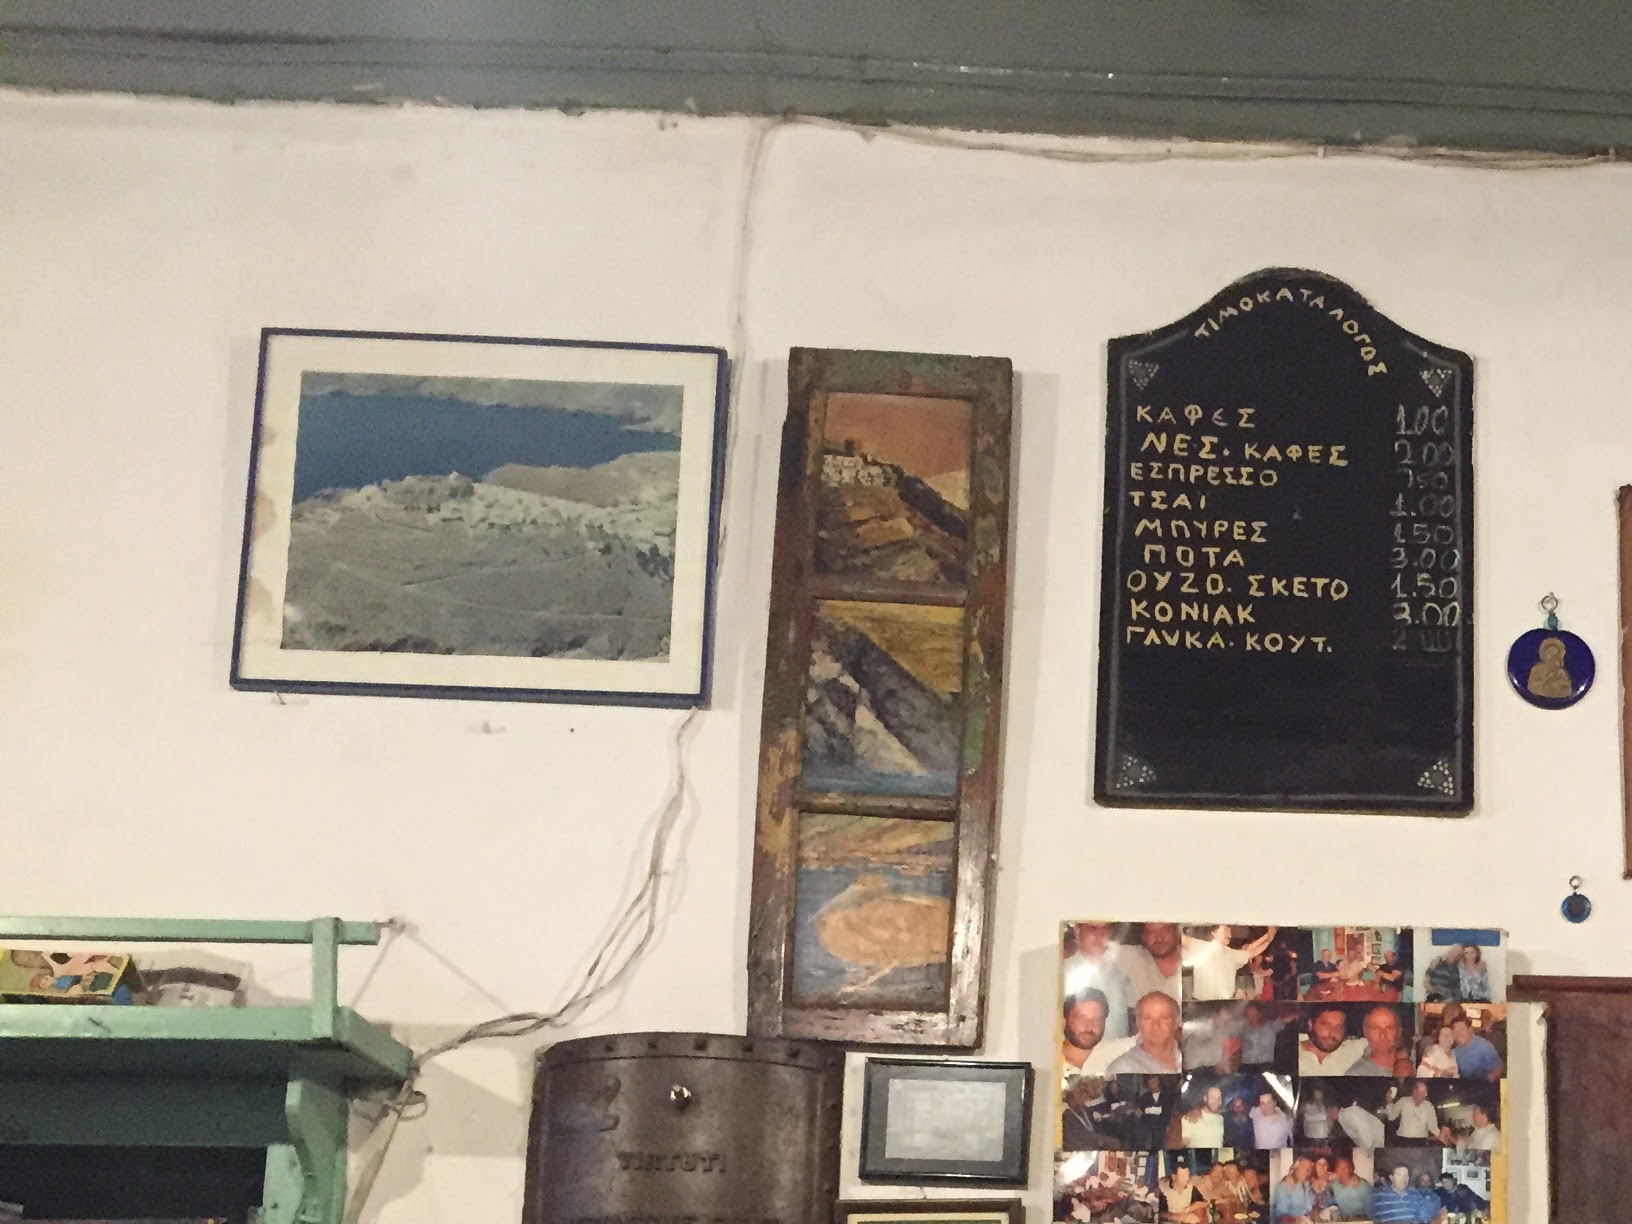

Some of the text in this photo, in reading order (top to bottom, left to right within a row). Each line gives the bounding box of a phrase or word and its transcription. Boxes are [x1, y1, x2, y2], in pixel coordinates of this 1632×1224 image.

[1194, 287, 1388, 377] ΤΙΜΟΚΑΤΑΛΟΓΟΣ
[1136, 404, 1256, 428] ΚΑΦΕΣ
[1244, 442, 1348, 467] ΚΑΦΕΣ
[1130, 462, 1278, 487] ΕΣΠΡΕΣΣΟ
[1129, 490, 1206, 510] ΤΣΑΙ
[1135, 518, 1268, 542] ΜΠΥΡΕΣ
[1143, 544, 1245, 568] ΠΟΤΑ
[1248, 574, 1349, 601] ΣΚΕΤΟ
[1391, 572, 1458, 598] 1.50
[1130, 598, 1256, 626] ΚΟΝΙΑΚ
[616, 1150, 727, 1174] VIRTUTI
